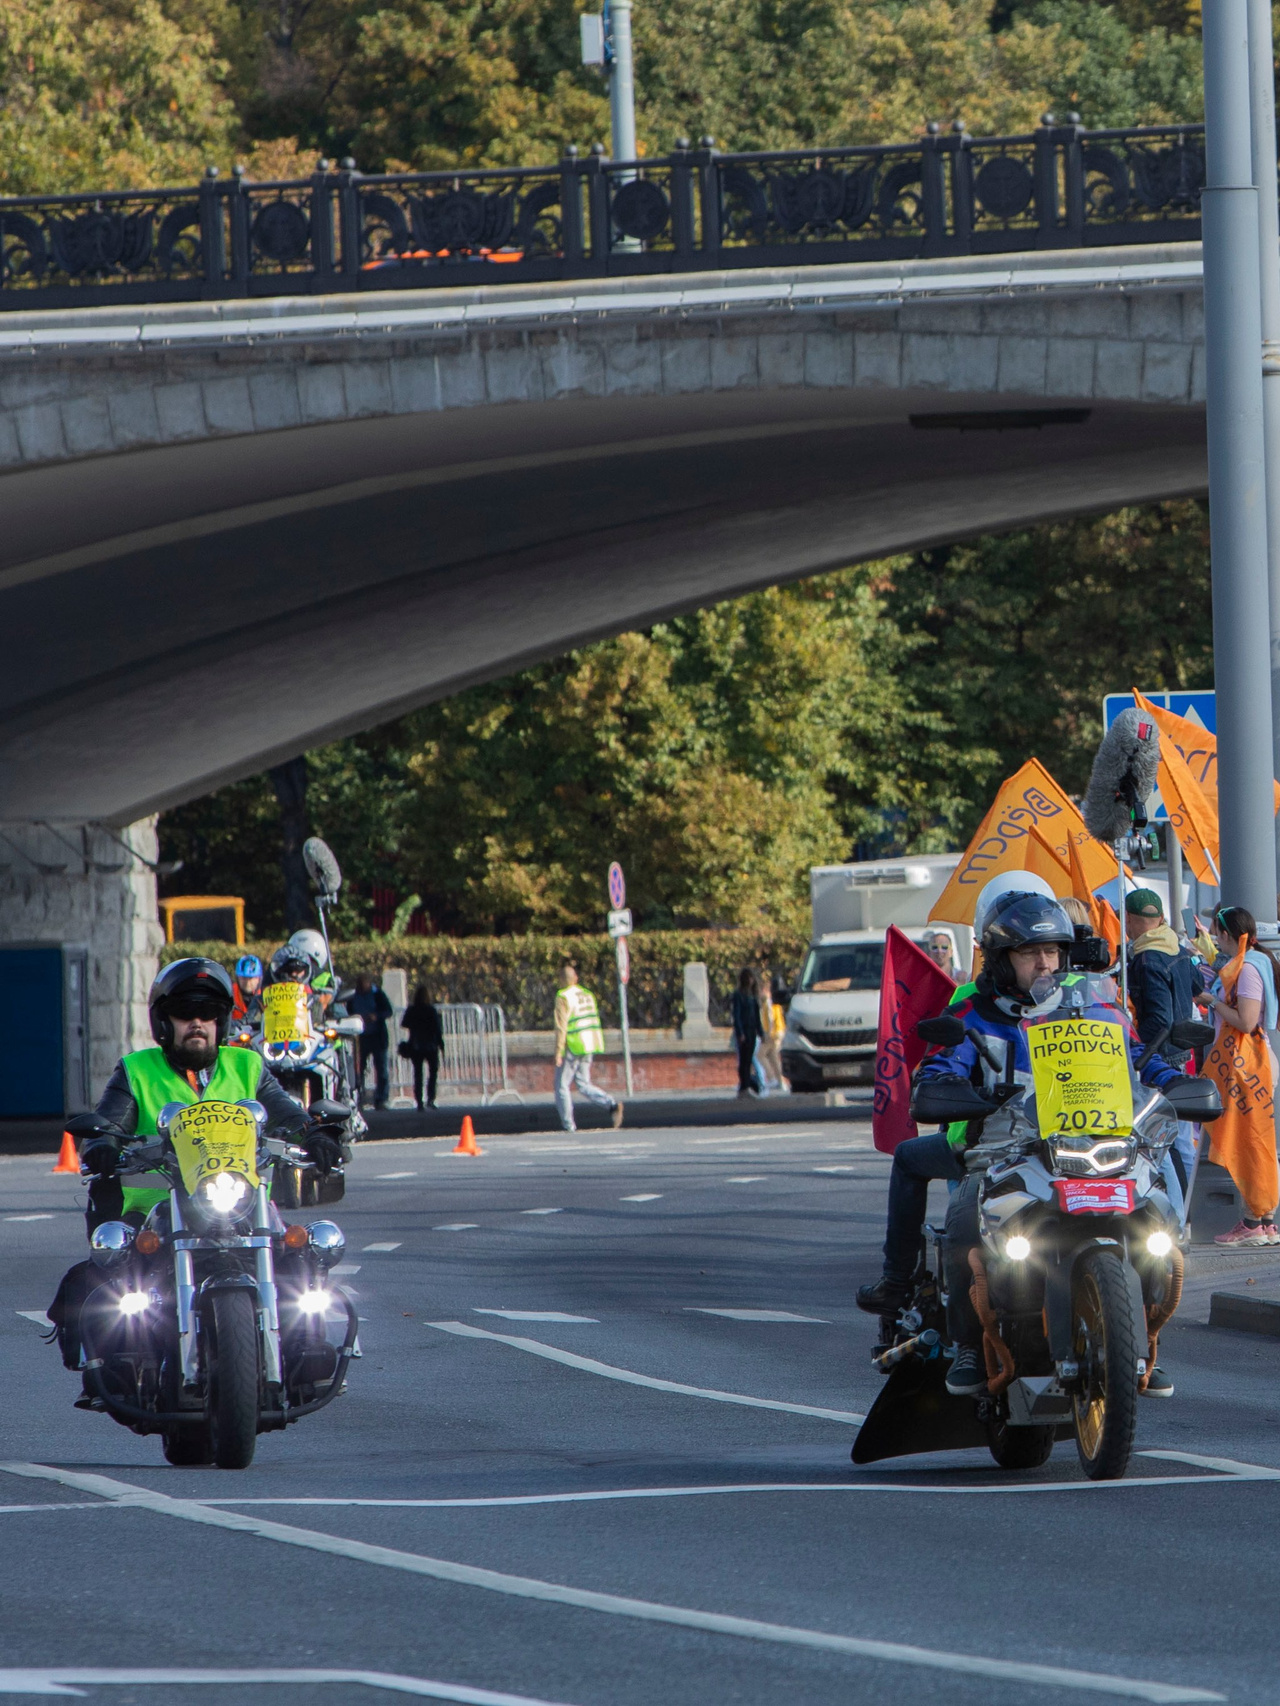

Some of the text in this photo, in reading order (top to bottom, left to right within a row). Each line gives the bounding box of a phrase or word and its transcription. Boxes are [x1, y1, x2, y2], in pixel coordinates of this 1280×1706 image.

[1038, 1023, 1114, 1040] ТРАССА
[1033, 1040, 1123, 1059] ПРОПУСК
[1061, 1081, 1114, 1089] МОСКОВСКИЙ
[1210, 1049, 1253, 1116] ОСКВЫ
[175, 1103, 247, 1120] ТРАССА
[1063, 1098, 1105, 1106] MARATHON
[173, 1114, 254, 1139] ПРОПУСК
[1056, 1109, 1118, 1131] 2023
[195, 1156, 249, 1179] 2023
